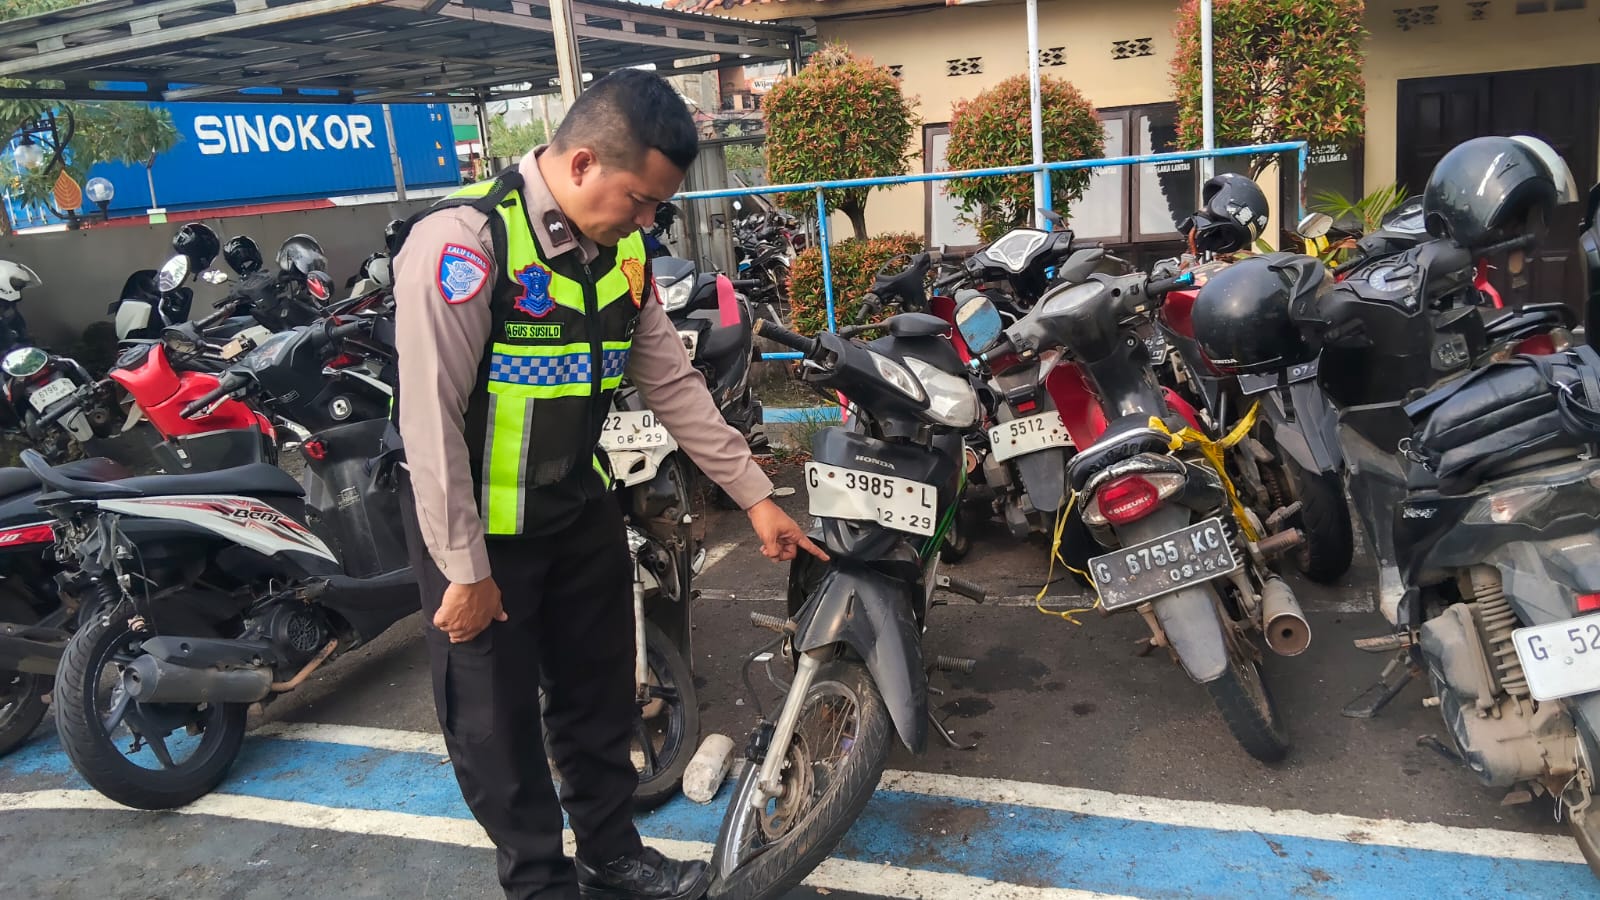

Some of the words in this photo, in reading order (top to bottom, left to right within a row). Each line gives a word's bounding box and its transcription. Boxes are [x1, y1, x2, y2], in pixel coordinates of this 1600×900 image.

[194, 115, 375, 154] SINOKOR
[447, 245, 466, 257] LALU
[465, 251, 487, 269] LINTAS
[507, 324, 528, 337] AGUS
[529, 325, 560, 337] SUSILO
[1010, 417, 1045, 437] 5512
[855, 454, 896, 471] HONDA
[845, 472, 895, 499] 3985
[921, 487, 932, 509] L
[1112, 494, 1152, 515] SUZUKI
[1096, 562, 1112, 584] G
[1125, 540, 1180, 575] 6755
[1190, 527, 1219, 554] KC
[1527, 634, 1549, 661] G
